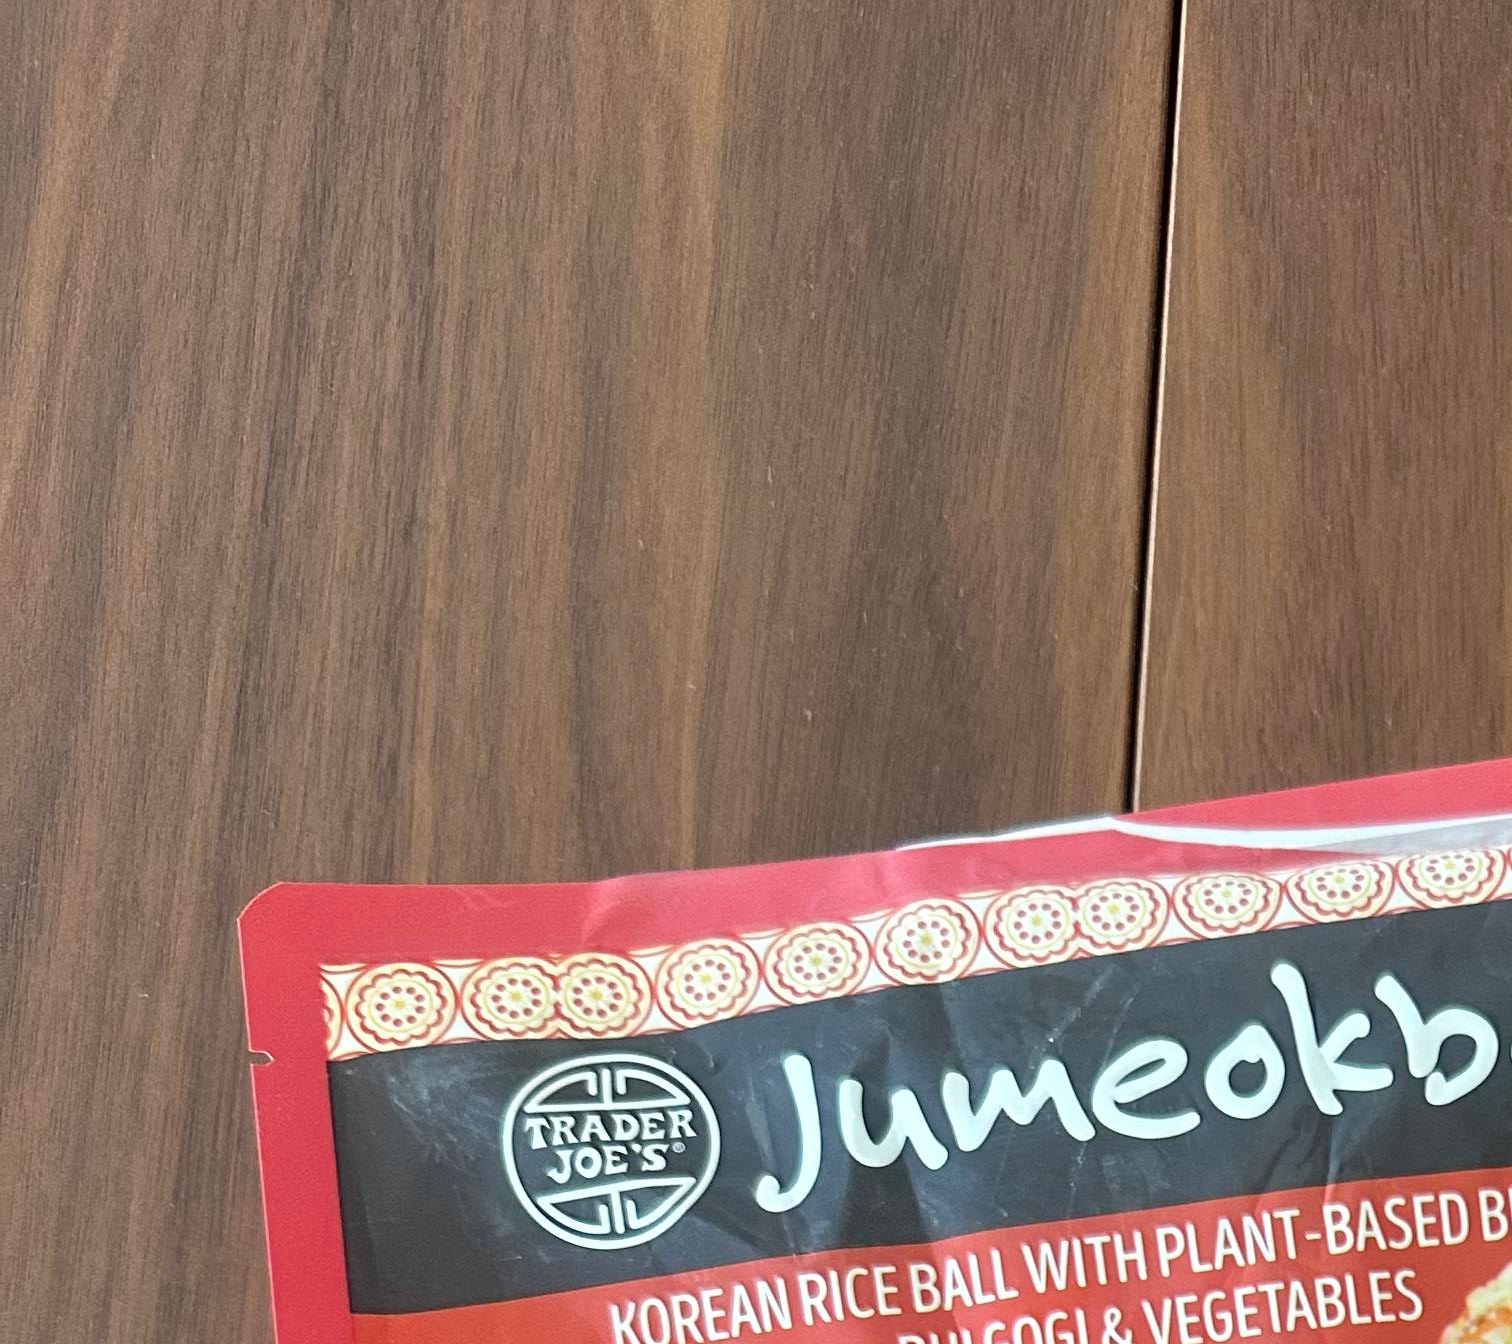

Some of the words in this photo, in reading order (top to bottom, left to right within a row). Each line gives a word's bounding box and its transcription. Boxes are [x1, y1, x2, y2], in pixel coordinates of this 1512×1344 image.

[525, 1109, 699, 1150] TRADER
[803, 1265, 900, 1326] RICE
[910, 1249, 1019, 1313] BALL
[1022, 1232, 1147, 1294] WITH
[1158, 1196, 1469, 1279] PLANT-BASED
